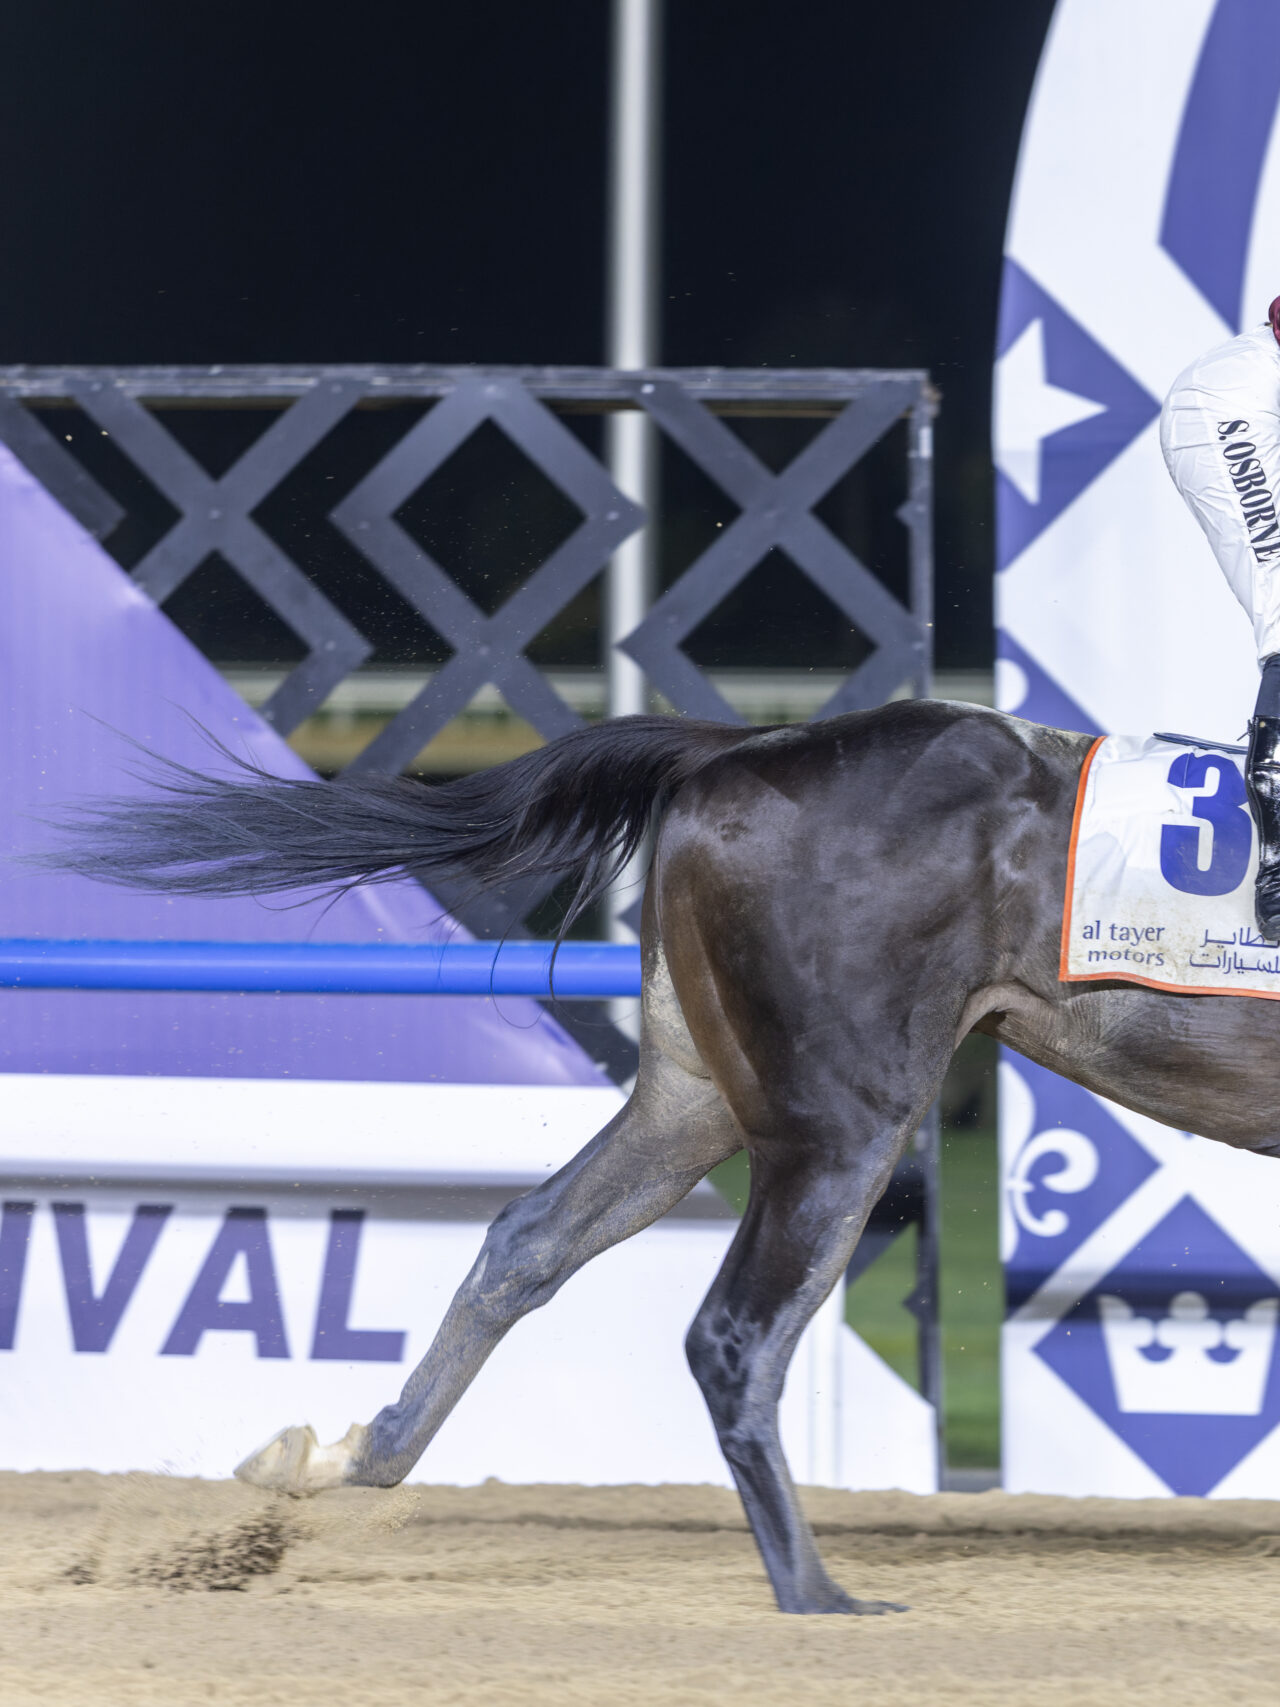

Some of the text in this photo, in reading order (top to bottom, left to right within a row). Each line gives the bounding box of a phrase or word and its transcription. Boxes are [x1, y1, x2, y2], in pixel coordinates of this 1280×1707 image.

[1160, 752, 1252, 897] 3
[1082, 920, 1166, 947] al tayer
[1088, 948, 1165, 967] motors
